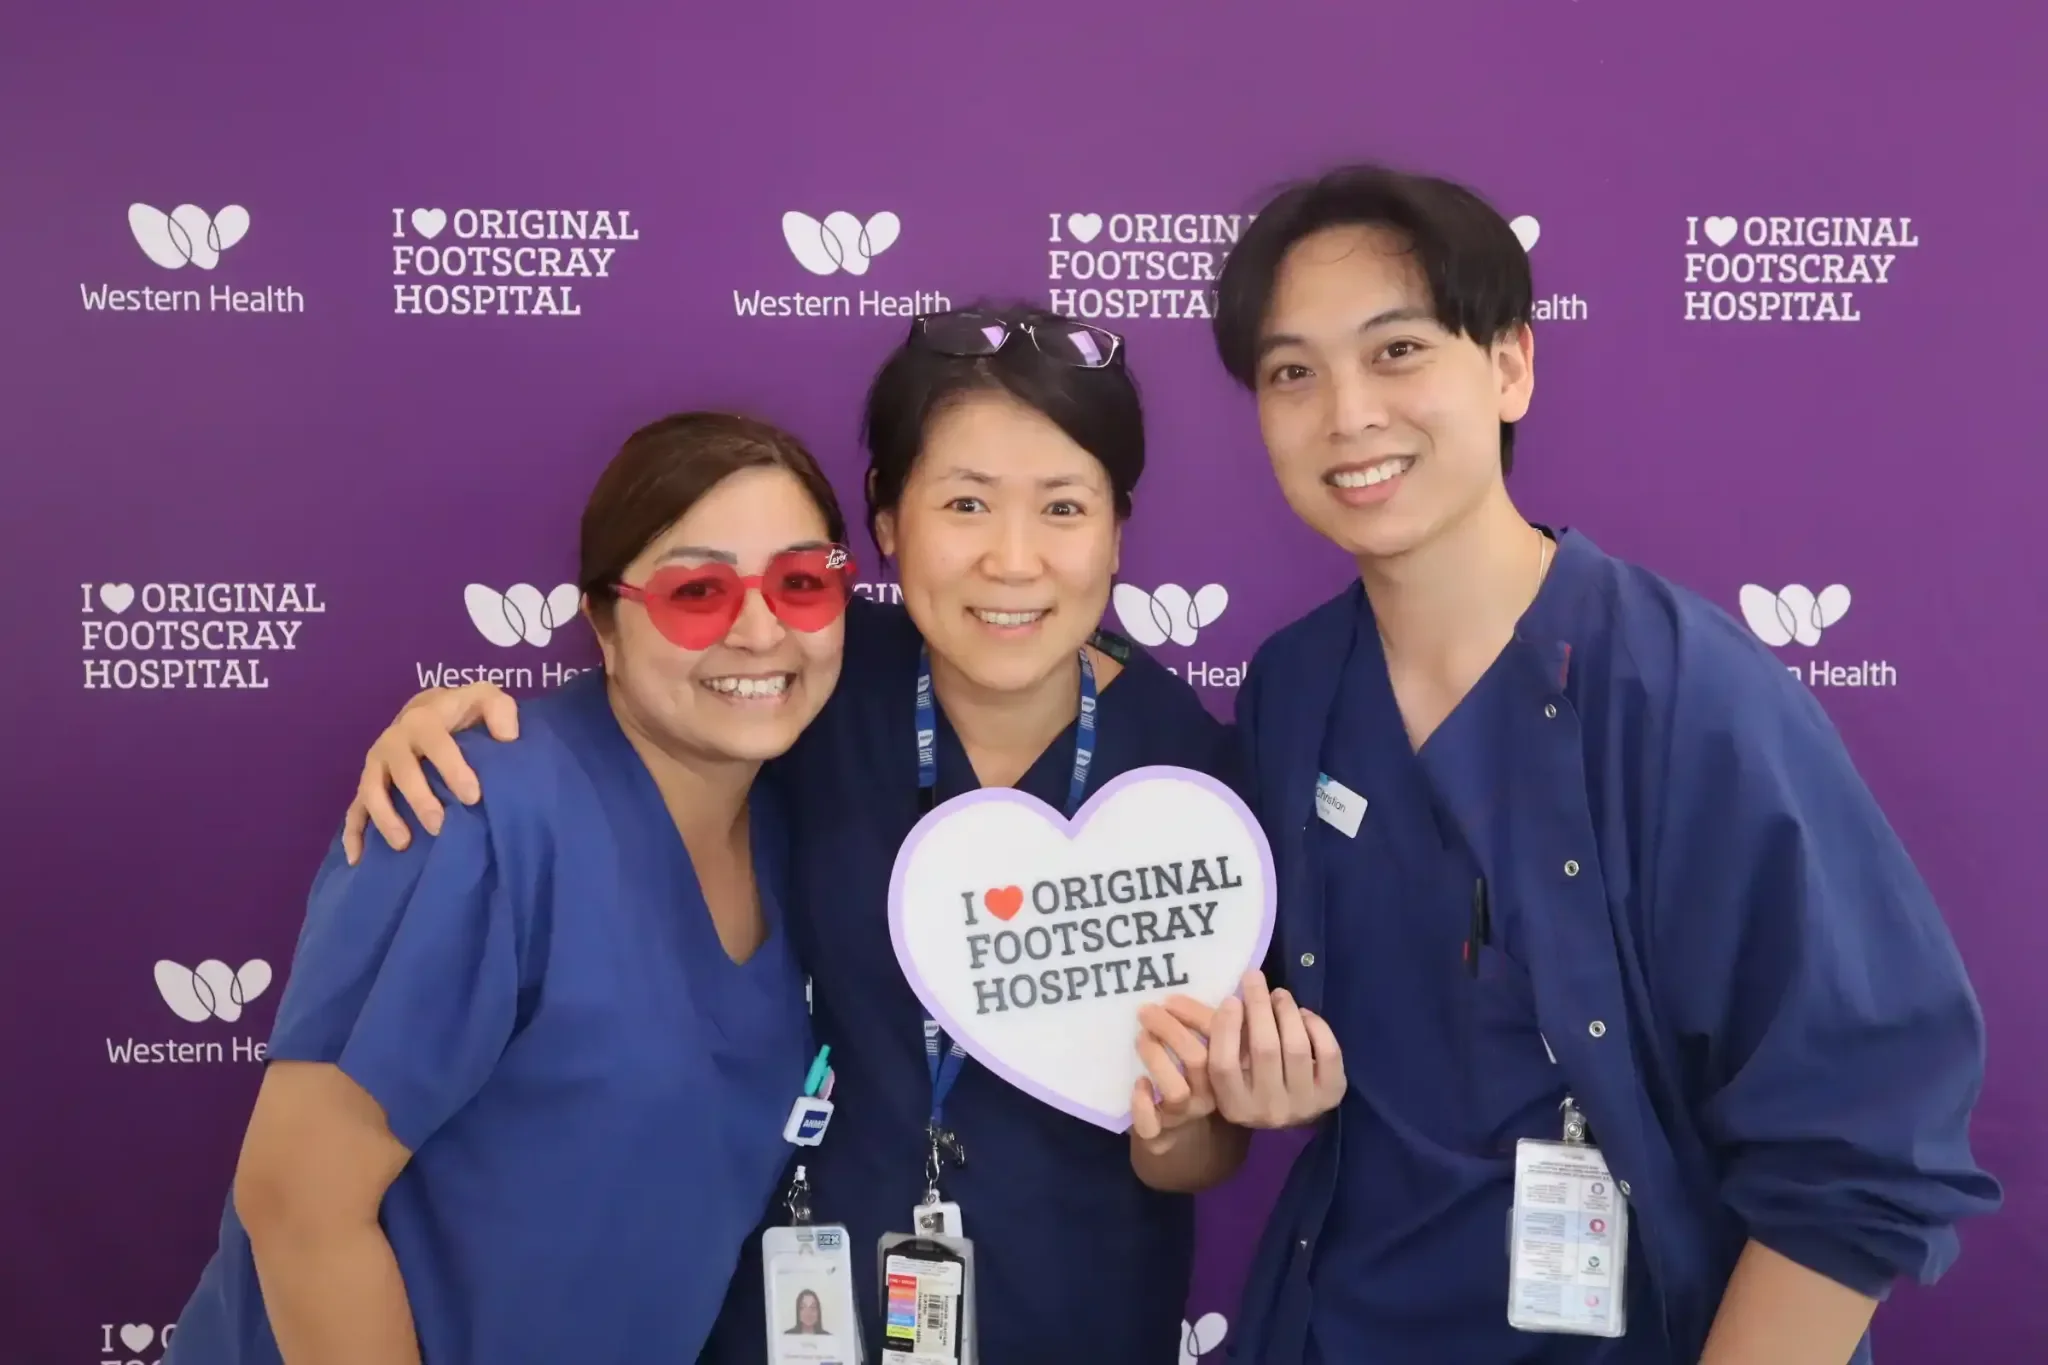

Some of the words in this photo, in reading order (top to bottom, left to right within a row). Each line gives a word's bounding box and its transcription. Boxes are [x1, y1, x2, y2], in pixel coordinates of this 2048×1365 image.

[392, 208, 405, 238] I
[453, 208, 639, 240] ORIGINAL
[1049, 213, 1062, 242] I
[1108, 213, 1259, 244] ORIGIN
[1686, 216, 1699, 246] I
[1743, 216, 1919, 247] ORIGINAL
[392, 245, 616, 277] FOOTSCRAY
[1684, 253, 1896, 284] FOOTSCRAY
[80, 283, 201, 312] Western
[210, 284, 304, 313] Health
[393, 284, 581, 316] HOSPITAL
[733, 289, 850, 317] Western
[859, 289, 951, 317] Health
[1049, 288, 1218, 319] HOSPITA
[1684, 291, 1861, 322] HOSPITAL
[80, 583, 94, 613] I
[141, 583, 326, 613] ORIGINAL
[81, 620, 303, 651] FOOTSCRAY
[83, 659, 269, 690] HOSPITAL
[416, 661, 532, 689] Western
[1810, 660, 1897, 687] Health
[961, 891, 980, 926] I
[1032, 856, 1242, 915] ORIGINAL
[966, 901, 1218, 969] FOOTSCRAY
[973, 952, 1188, 1015] HOSPITAL
[106, 1037, 223, 1064] Western
[101, 1323, 114, 1353] I
